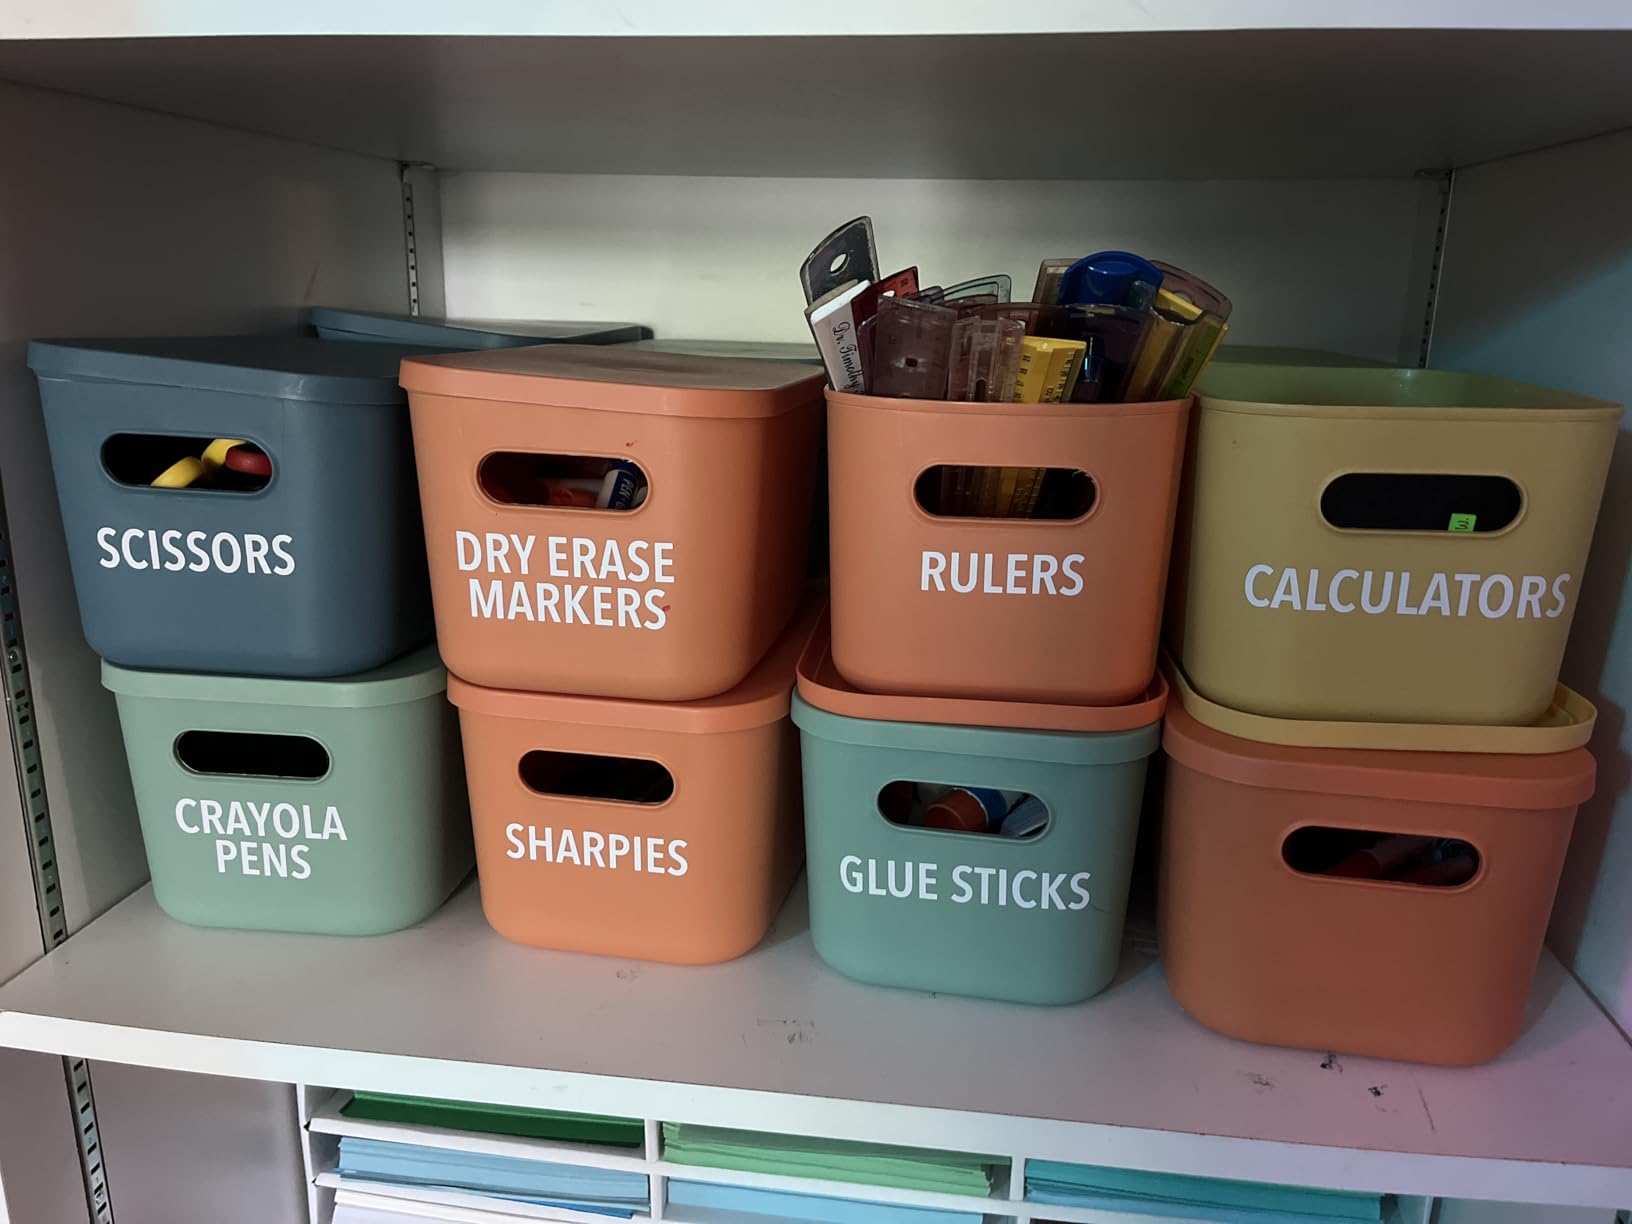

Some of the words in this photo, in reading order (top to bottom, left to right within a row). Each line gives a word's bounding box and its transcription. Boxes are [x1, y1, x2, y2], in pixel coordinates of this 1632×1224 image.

[97, 527, 295, 576] SCISSORS
[455, 530, 536, 575] DRY
[548, 536, 675, 584] ERASE
[921, 551, 1085, 597] RULERS
[469, 578, 667, 631] MARKERS
[1244, 563, 1570, 621] CALCULATORS
[175, 798, 348, 842] CRAYOLA
[215, 839, 312, 881] PENS
[505, 823, 689, 878] SHARPIES
[839, 855, 939, 902] GLUE
[950, 865, 1091, 912] STICKS
